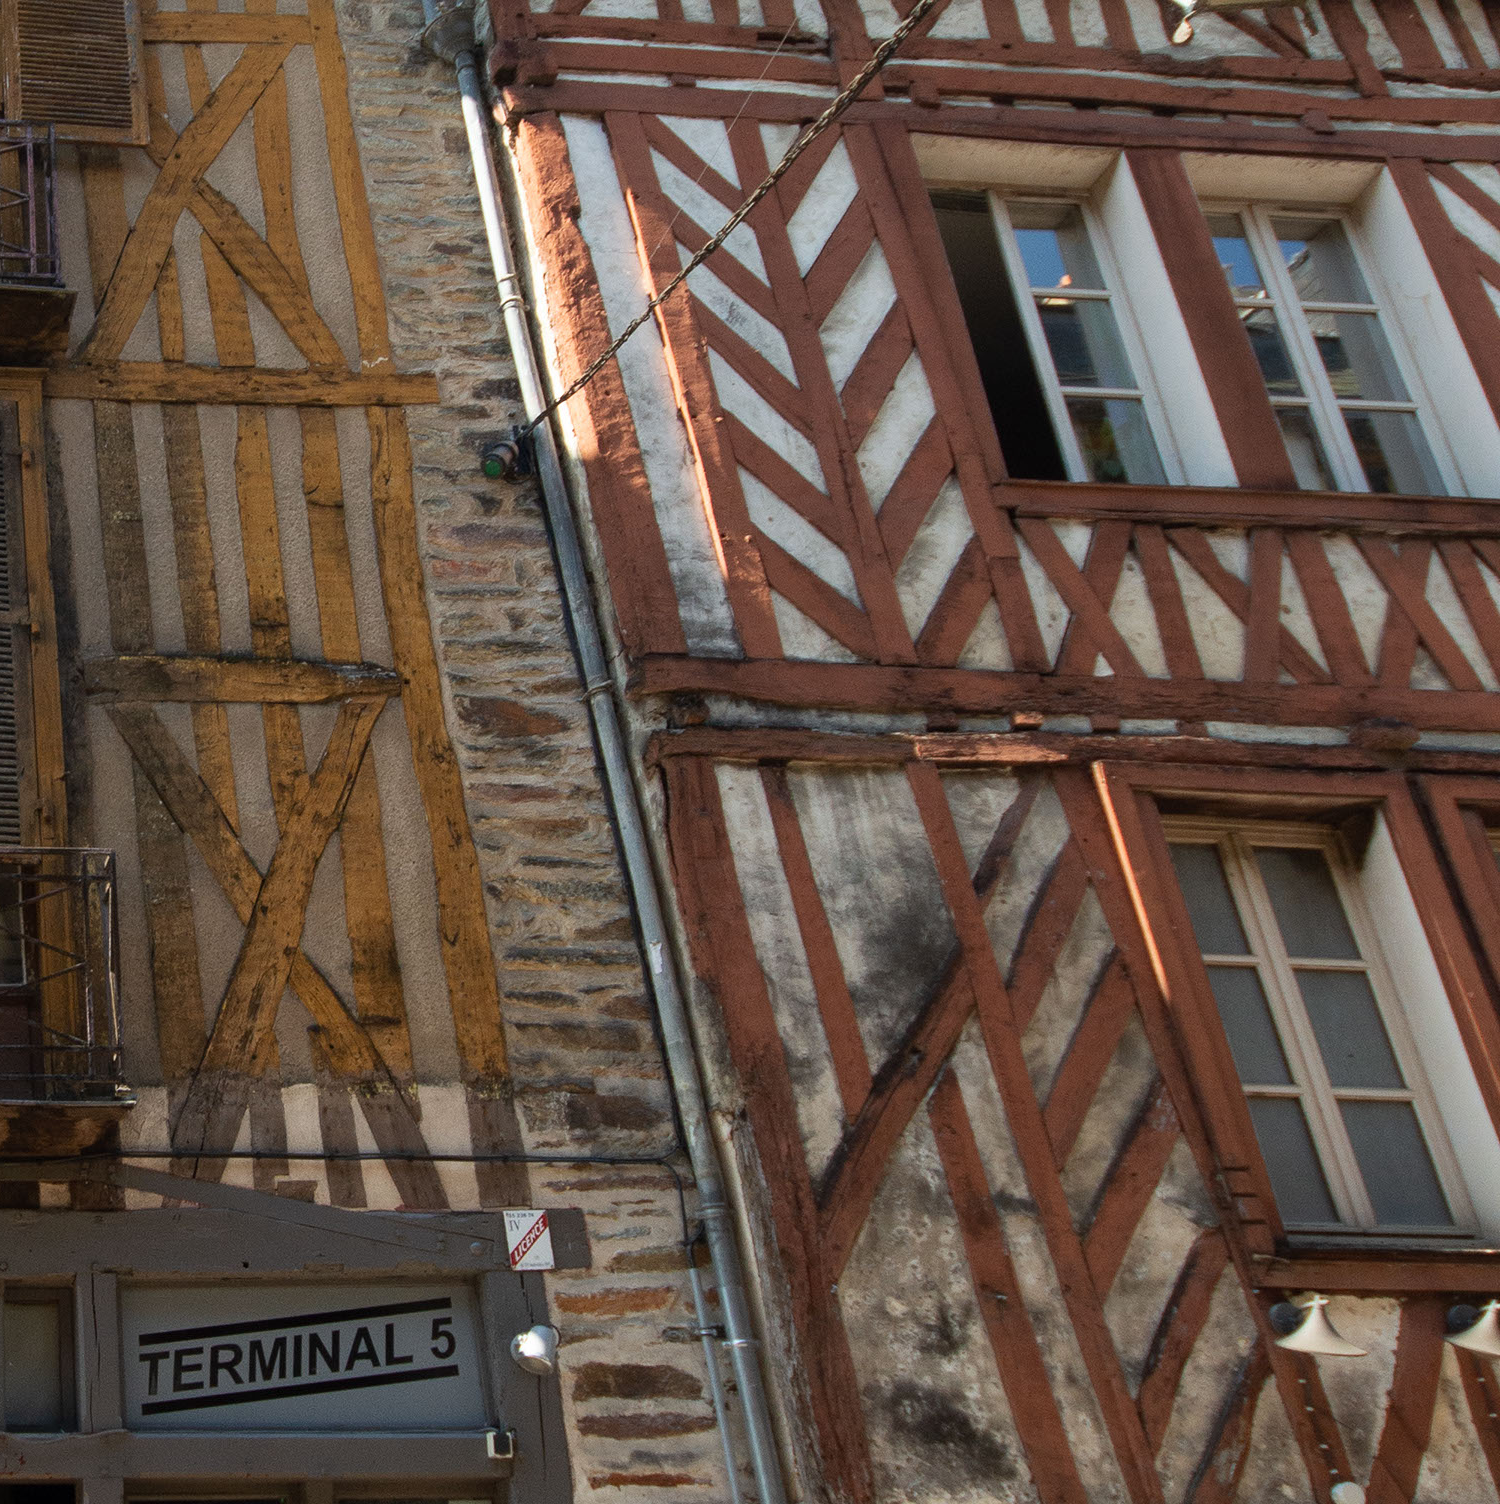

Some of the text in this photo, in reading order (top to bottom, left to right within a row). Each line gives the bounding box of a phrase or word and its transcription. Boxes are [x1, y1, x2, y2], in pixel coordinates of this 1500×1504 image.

[509, 1219, 521, 1232] IV
[514, 1217, 546, 1262] LICENCE
[139, 1316, 457, 1397] TERMINAL 5
